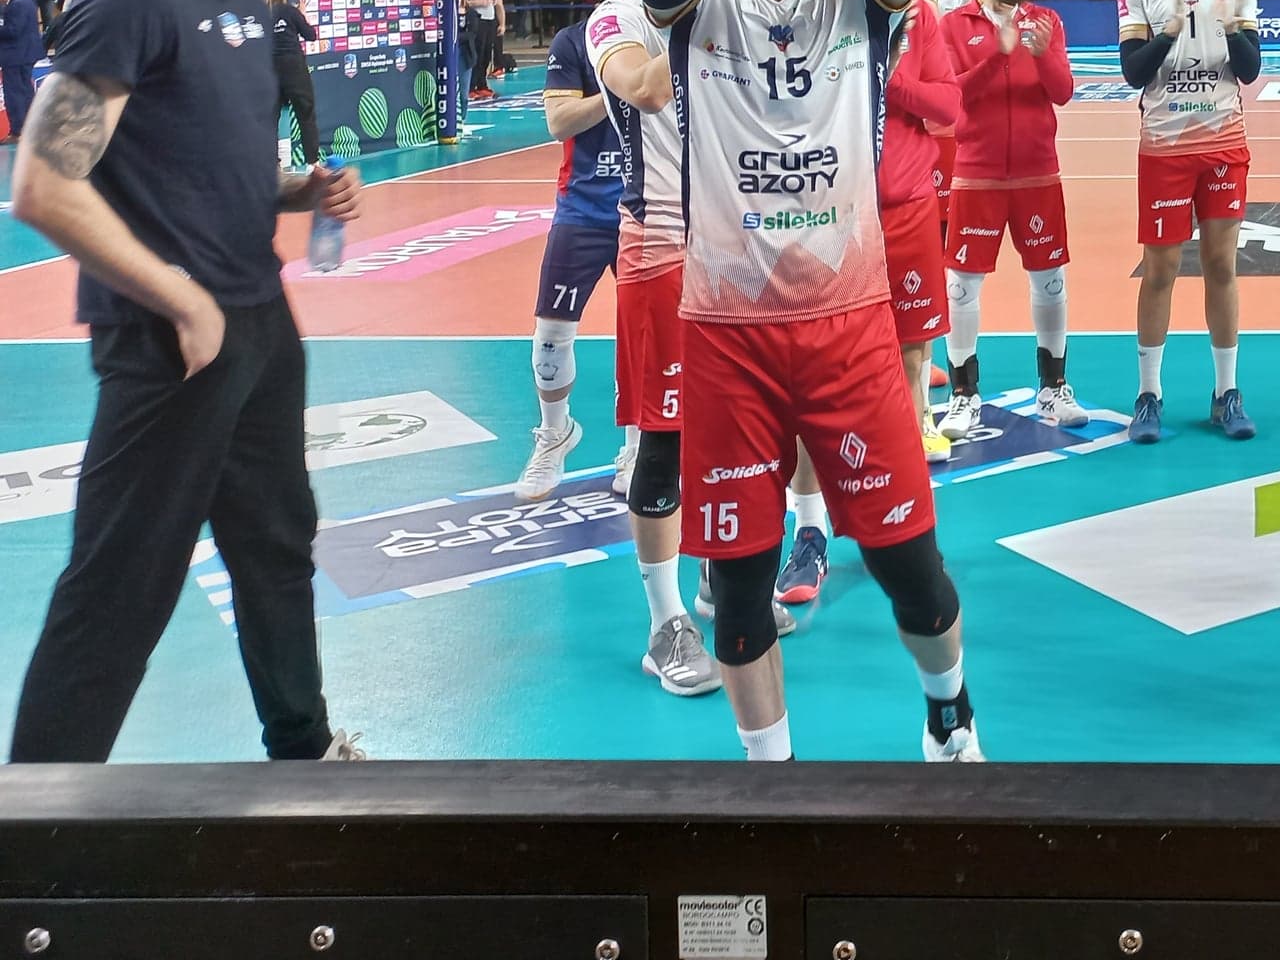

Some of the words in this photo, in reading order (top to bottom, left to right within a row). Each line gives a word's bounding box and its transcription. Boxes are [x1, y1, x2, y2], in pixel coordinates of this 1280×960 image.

[1186, 11, 1195, 39] 1
[758, 55, 812, 100] 15
[1221, 182, 1237, 190] Car
[763, 206, 837, 230] silekol
[1155, 217, 1163, 238] 1
[1025, 238, 1039, 247] Vip
[1039, 235, 1055, 244] Car
[955, 244, 968, 264] 4
[552, 284, 578, 312] 71
[912, 297, 931, 308] Car
[863, 472, 893, 489] Car
[700, 502, 739, 542] 15
